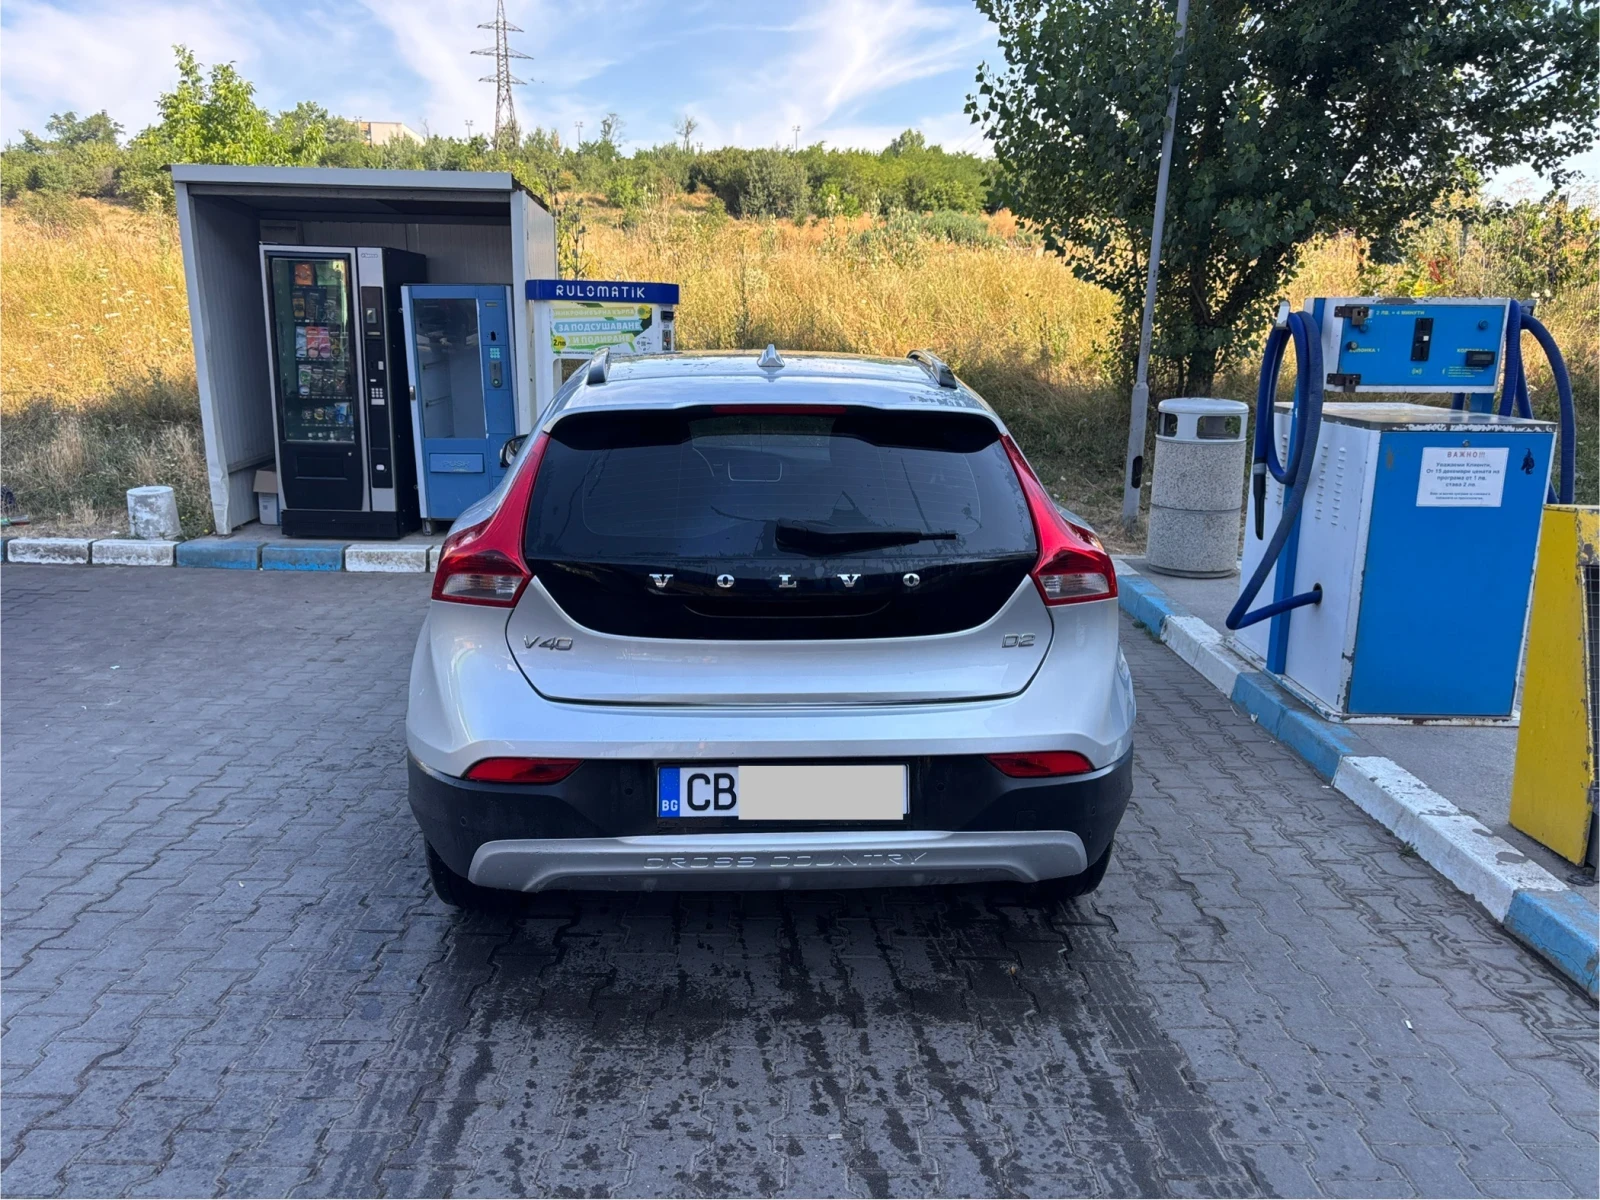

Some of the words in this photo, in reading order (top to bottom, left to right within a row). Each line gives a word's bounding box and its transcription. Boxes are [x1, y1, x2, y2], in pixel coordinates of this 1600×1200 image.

[558, 324, 570, 332] ЗА
[571, 322, 640, 332] ПОДСУШАВАНЕ
[572, 336, 579, 344] И
[580, 335, 631, 344] ПОЛИРАНЕ
[649, 572, 921, 589] VOLVO
[523, 634, 574, 651] V40
[1001, 632, 1036, 649] D2
[661, 799, 679, 812] BG
[643, 855, 757, 869] CROSS
[769, 851, 927, 868] COUNTRY
